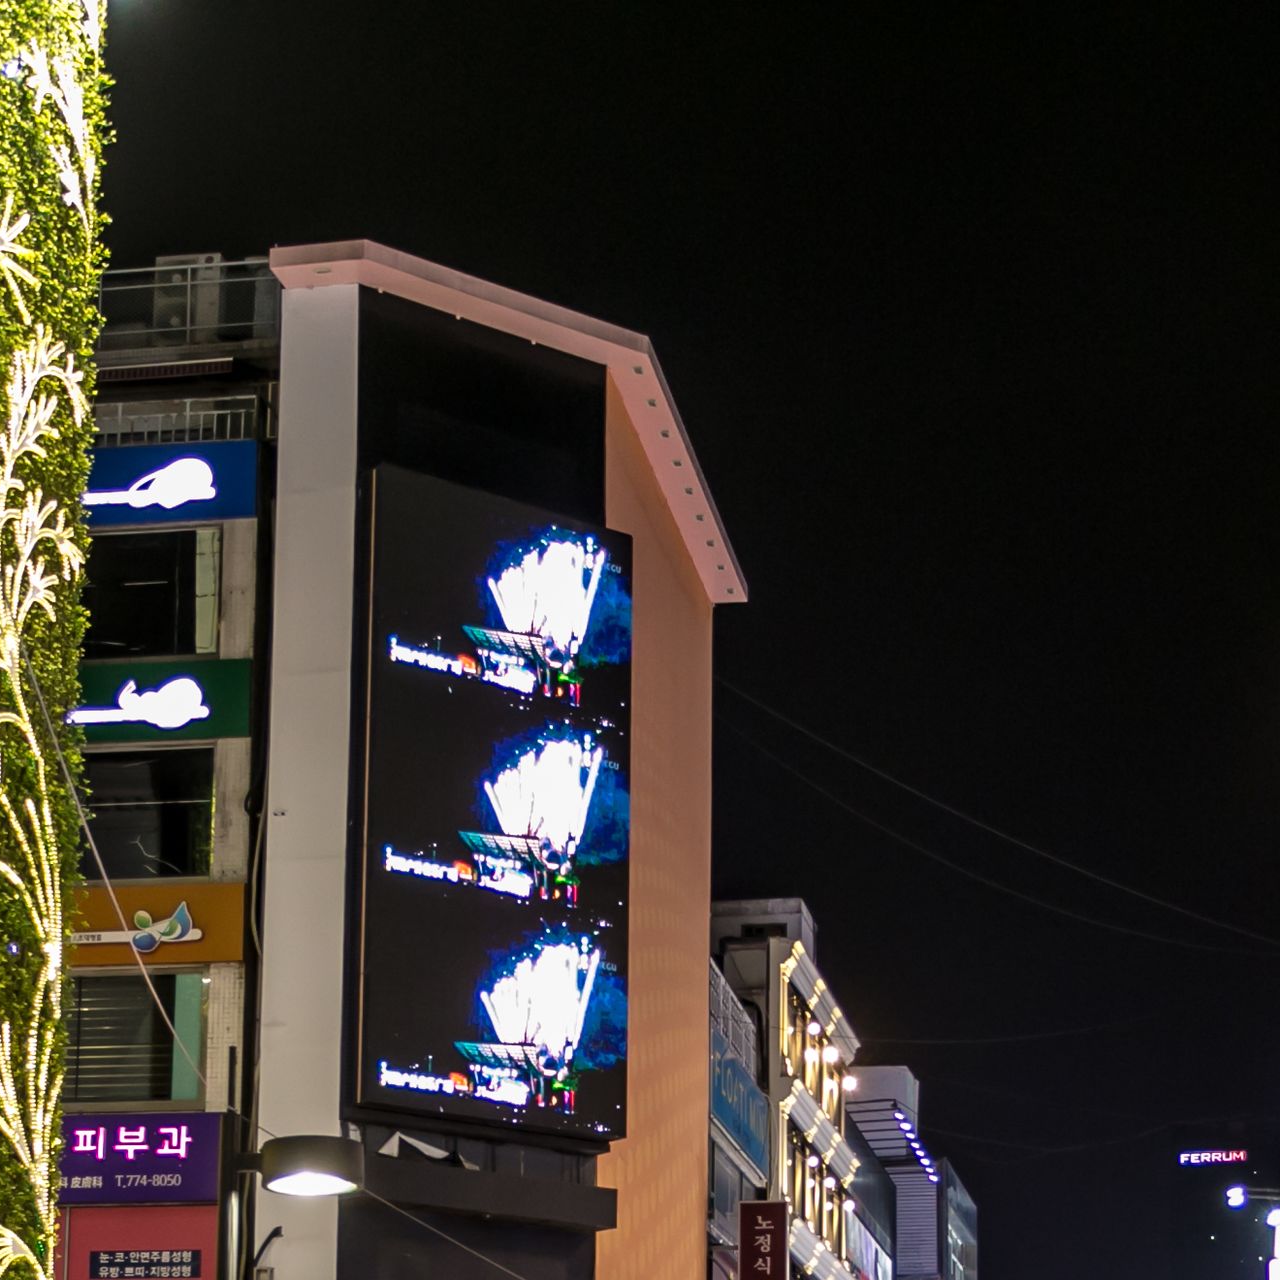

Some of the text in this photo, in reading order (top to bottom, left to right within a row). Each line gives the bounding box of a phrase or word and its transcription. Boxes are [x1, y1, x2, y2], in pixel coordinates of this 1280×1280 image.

[73, 1126, 193, 1160] 피부과
[1180, 1151, 1244, 1164] FERRUM
[115, 1174, 182, 1189] T.774-8050
[754, 1216, 774, 1274] 노정식
